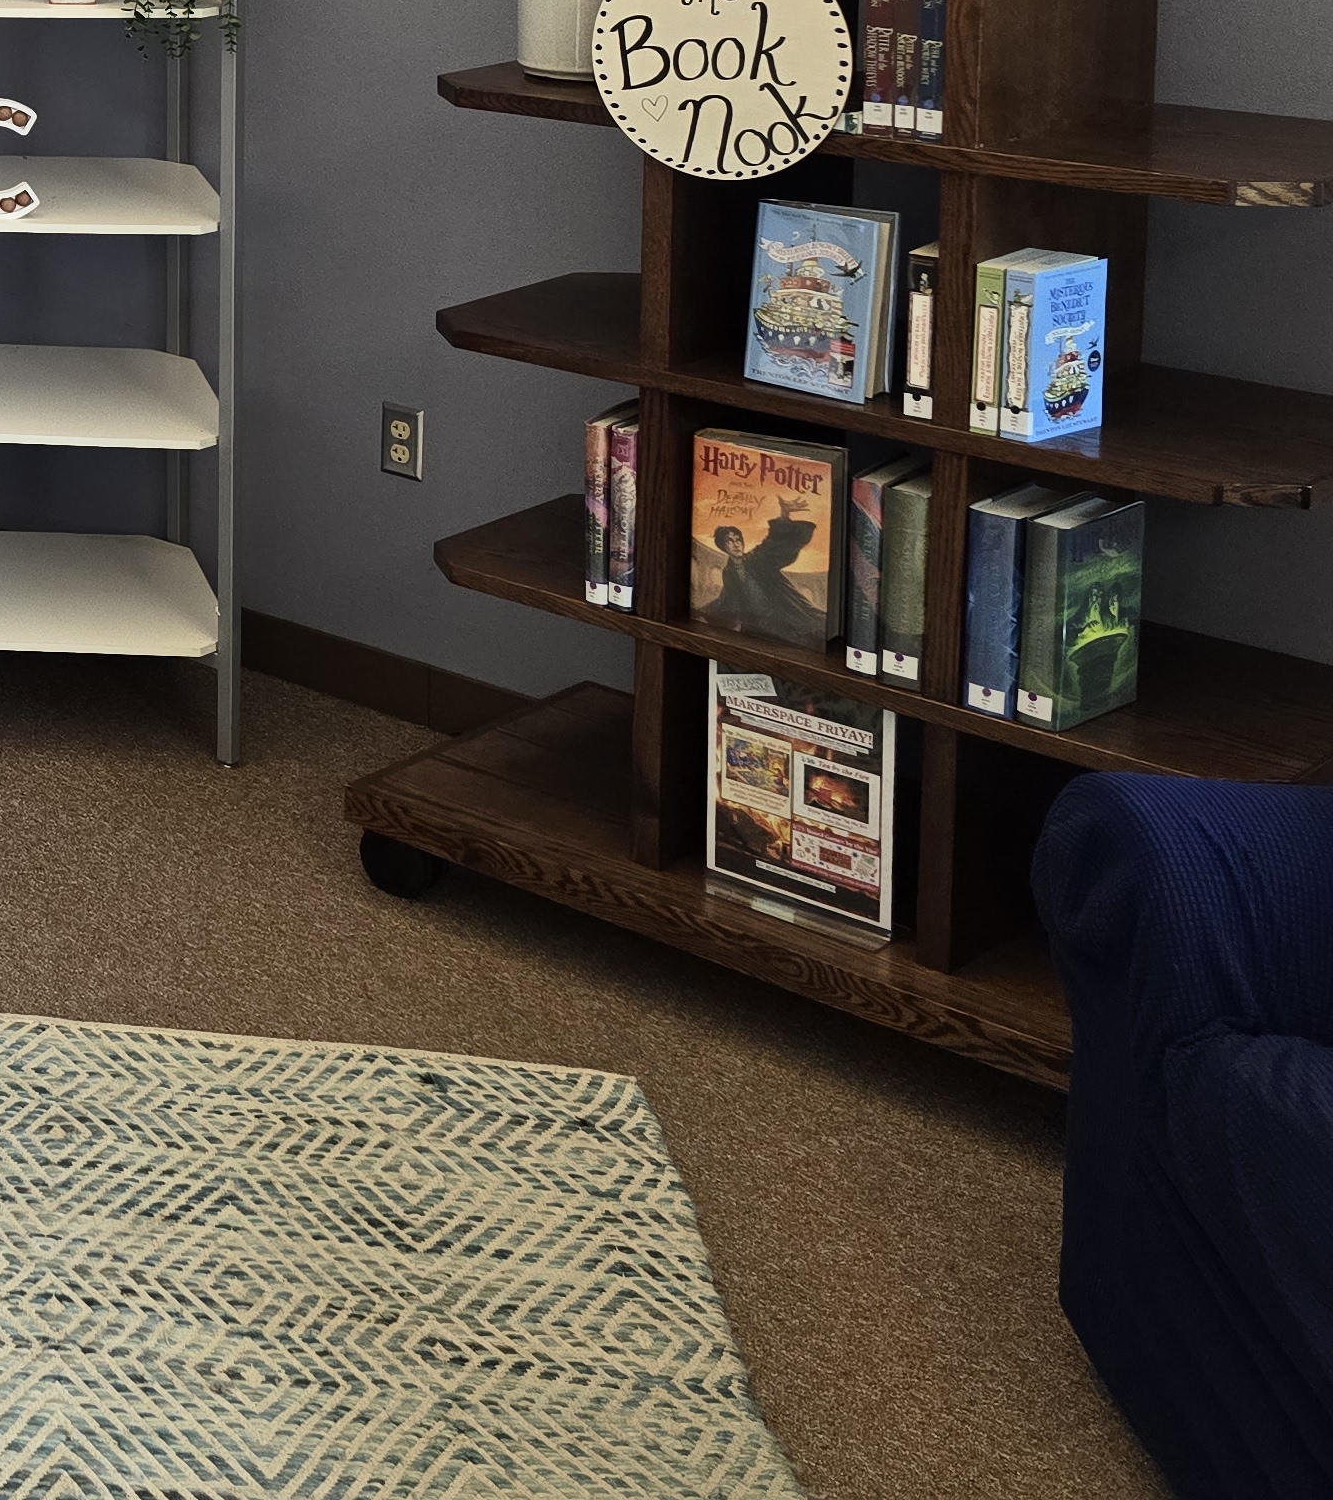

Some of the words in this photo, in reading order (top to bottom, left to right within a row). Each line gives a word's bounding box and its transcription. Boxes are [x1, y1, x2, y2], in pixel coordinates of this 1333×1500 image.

[610, 1, 797, 91] Book
[698, 445, 758, 479] Harry
[759, 452, 824, 496] Potter
[726, 695, 812, 729] MAKERSPACE
[817, 721, 873, 746] FRIYAY!
